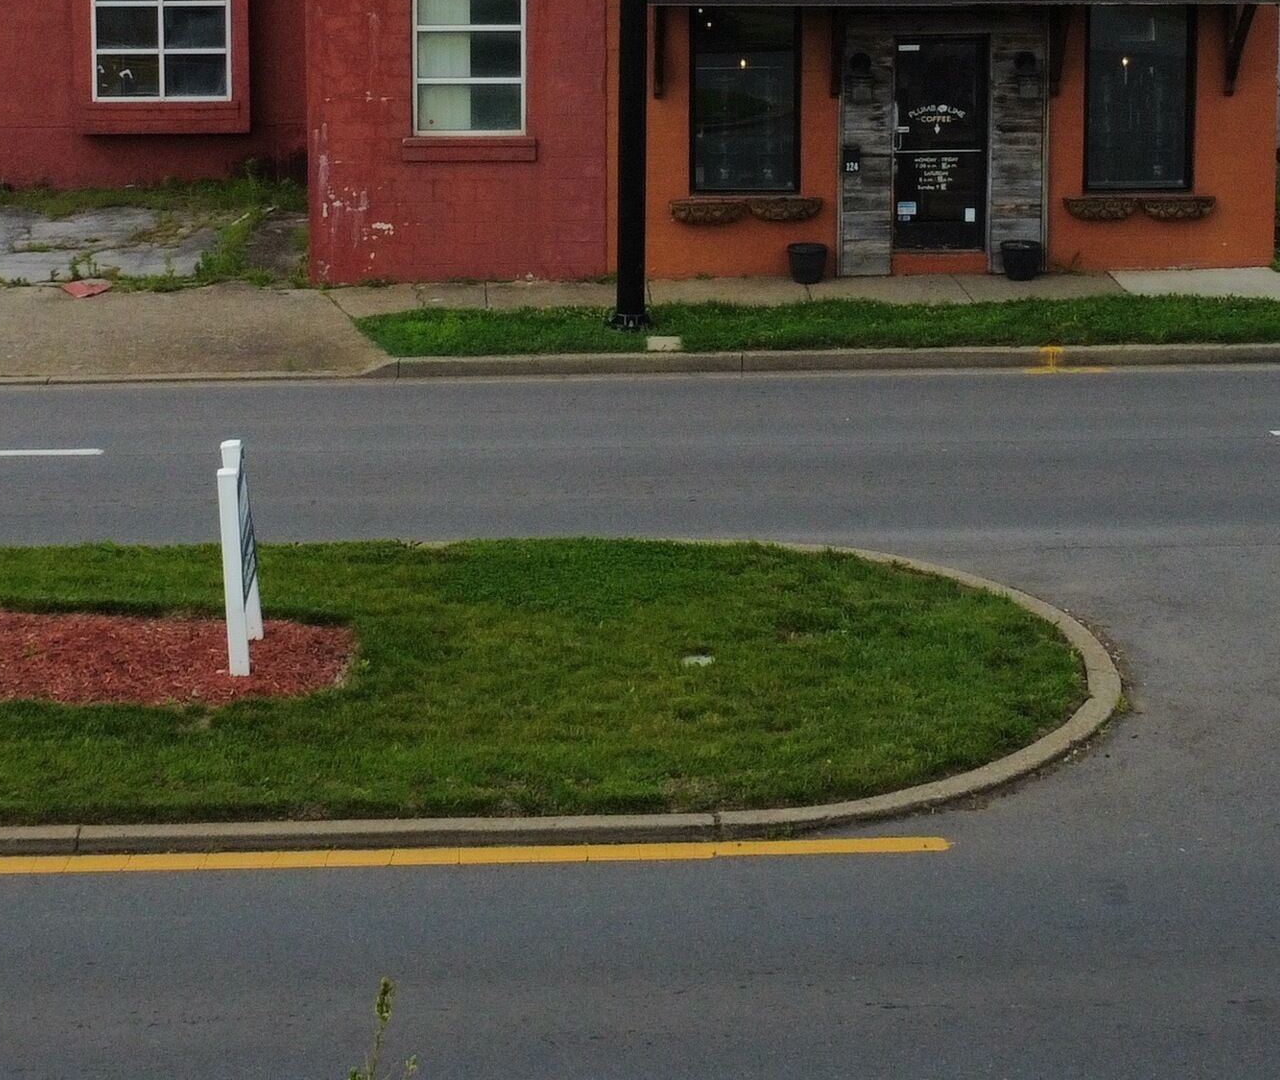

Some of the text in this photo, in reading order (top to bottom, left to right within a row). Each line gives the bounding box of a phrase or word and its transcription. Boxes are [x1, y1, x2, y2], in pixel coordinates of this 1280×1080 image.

[908, 104, 966, 119] PLUMB LINE
[920, 115, 952, 123] COFFEE
[845, 161, 859, 172] 124
